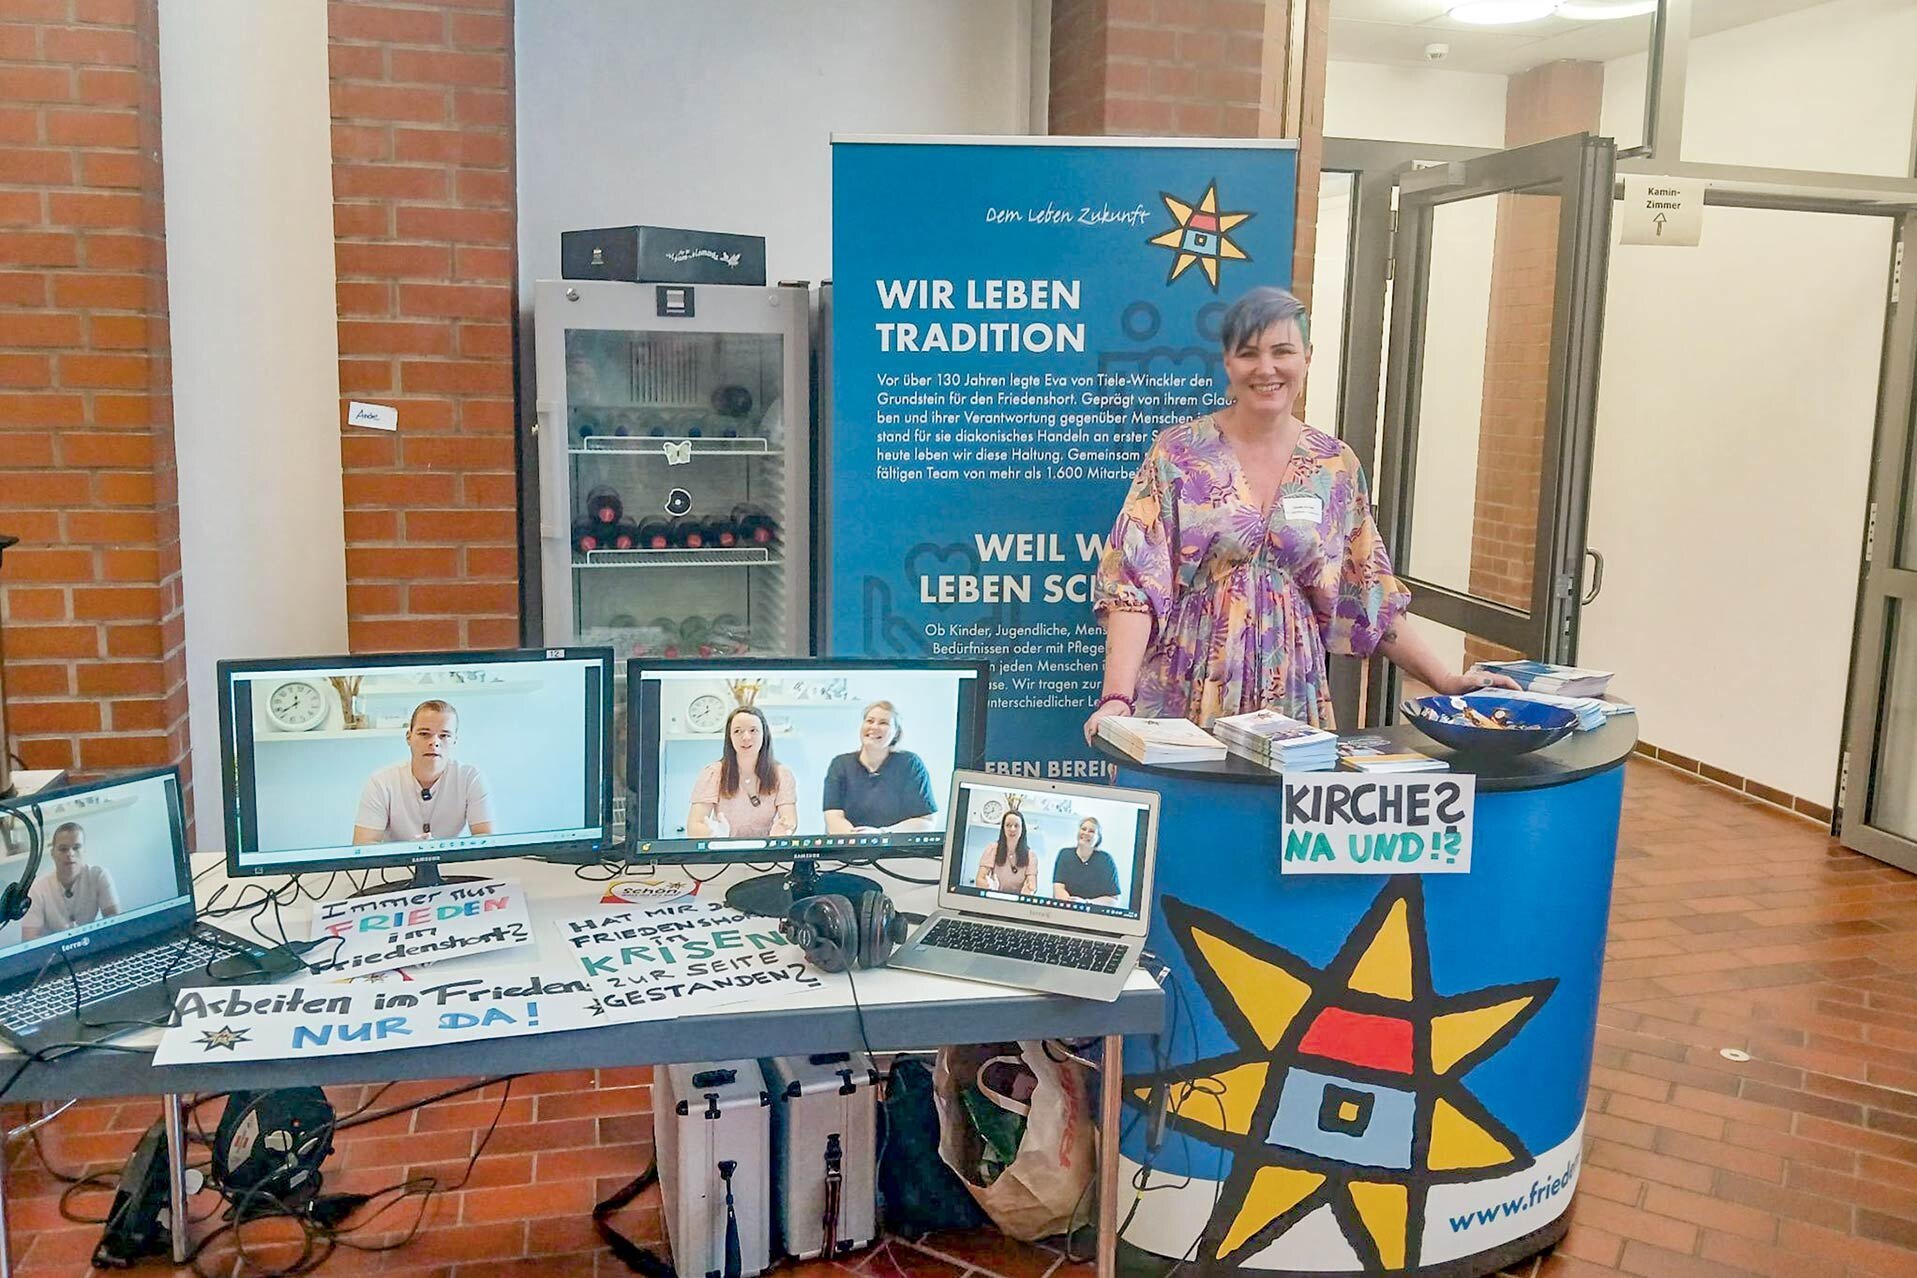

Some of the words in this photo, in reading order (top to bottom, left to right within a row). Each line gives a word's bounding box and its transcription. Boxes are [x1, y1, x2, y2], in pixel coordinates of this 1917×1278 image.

[1646, 200, 1681, 209] Zimmer
[1648, 187, 1681, 196] Kamin-
[986, 207, 1023, 223] Dem
[1028, 201, 1074, 224] Leben
[1077, 202, 1151, 227] Zukunft
[876, 279, 955, 310] WIR
[967, 279, 1081, 310] LEBEN
[876, 322, 1086, 353] TRADITION
[877, 373, 899, 387] Vor
[903, 373, 932, 387] über
[937, 373, 961, 387] 130
[964, 373, 1006, 387] Jahren
[1010, 373, 1040, 390] legte
[1045, 373, 1067, 387] Eva
[1071, 376, 1094, 387] von
[1097, 373, 1186, 387] Tiele-Winckler
[1190, 373, 1213, 387] den
[877, 392, 945, 406] Grundstein
[949, 392, 967, 406] für
[970, 392, 993, 406] den
[998, 392, 1077, 406] Friedenshort.
[1081, 392, 1134, 408] Geprägt
[1138, 395, 1160, 406] von
[1164, 392, 1198, 406] ihrem
[877, 411, 899, 424] ben
[904, 411, 928, 424] und
[931, 411, 960, 424] ihrer
[964, 411, 1056, 427] Verantwortung
[1060, 411, 1131, 427] gegenüber
[1131, 411, 1193, 424] Menschen
[877, 429, 910, 443] stand
[914, 429, 931, 443] für
[935, 429, 951, 443] sie
[955, 429, 1033, 443] diakonisches
[1038, 429, 1089, 443] Handeln
[1094, 433, 1109, 443] an
[1114, 432, 1148, 443] erster
[877, 447, 910, 461] heute
[914, 447, 949, 461] leben
[953, 447, 972, 461] wir
[975, 447, 1007, 461] diese
[1012, 447, 1063, 464] Haltung.
[1068, 447, 1140, 461] Gemeinsam
[877, 466, 923, 482] fältigen
[927, 466, 959, 480] Team
[963, 470, 985, 480] von
[989, 466, 1021, 480] mehr
[1024, 466, 1042, 480] als
[1047, 466, 1083, 480] 1.600
[1087, 466, 1139, 480] Mitarbei
[975, 533, 1066, 562] WEIL
[1076, 533, 1111, 562] W
[920, 575, 1031, 604] LEBEN
[1043, 574, 1096, 604] SC
[925, 623, 945, 637] Ob
[950, 623, 992, 638] Kinder,
[995, 623, 1071, 639] Jugendliche,
[1075, 623, 1107, 636] Mens
[933, 641, 1010, 655] Bedürfnissen
[1013, 641, 1042, 655] oder
[1046, 641, 1064, 655] mit
[1068, 641, 1107, 656] Pflege
[999, 660, 1033, 674] jeden
[1037, 660, 1098, 672] Menschen
[1012, 678, 1034, 690] Wir
[1038, 679, 1078, 693] tragen
[1082, 680, 1103, 690] zur
[988, 695, 1084, 708] nterschiedlicher
[985, 761, 1041, 778] EBEN
[1047, 760, 1108, 778] BEREI
[1284, 829, 1336, 863] NA
[321, 891, 442, 920] Immer
[450, 883, 506, 901] nur
[325, 895, 510, 937] FRIEDEN
[568, 913, 632, 933] HAT
[645, 904, 698, 919] MIR
[568, 912, 752, 948] FRIEDENSHO
[307, 922, 528, 975] Friedenshort?
[581, 929, 789, 977] KRISEN
[608, 969, 676, 988] ZUR
[687, 950, 780, 977] SEITE
[603, 962, 822, 1008] GESTANDEN?
[172, 988, 352, 1022] Arbeiten
[420, 976, 593, 1006] Frieden
[291, 1015, 414, 1049] NUR
[438, 1002, 540, 1027] DA!
